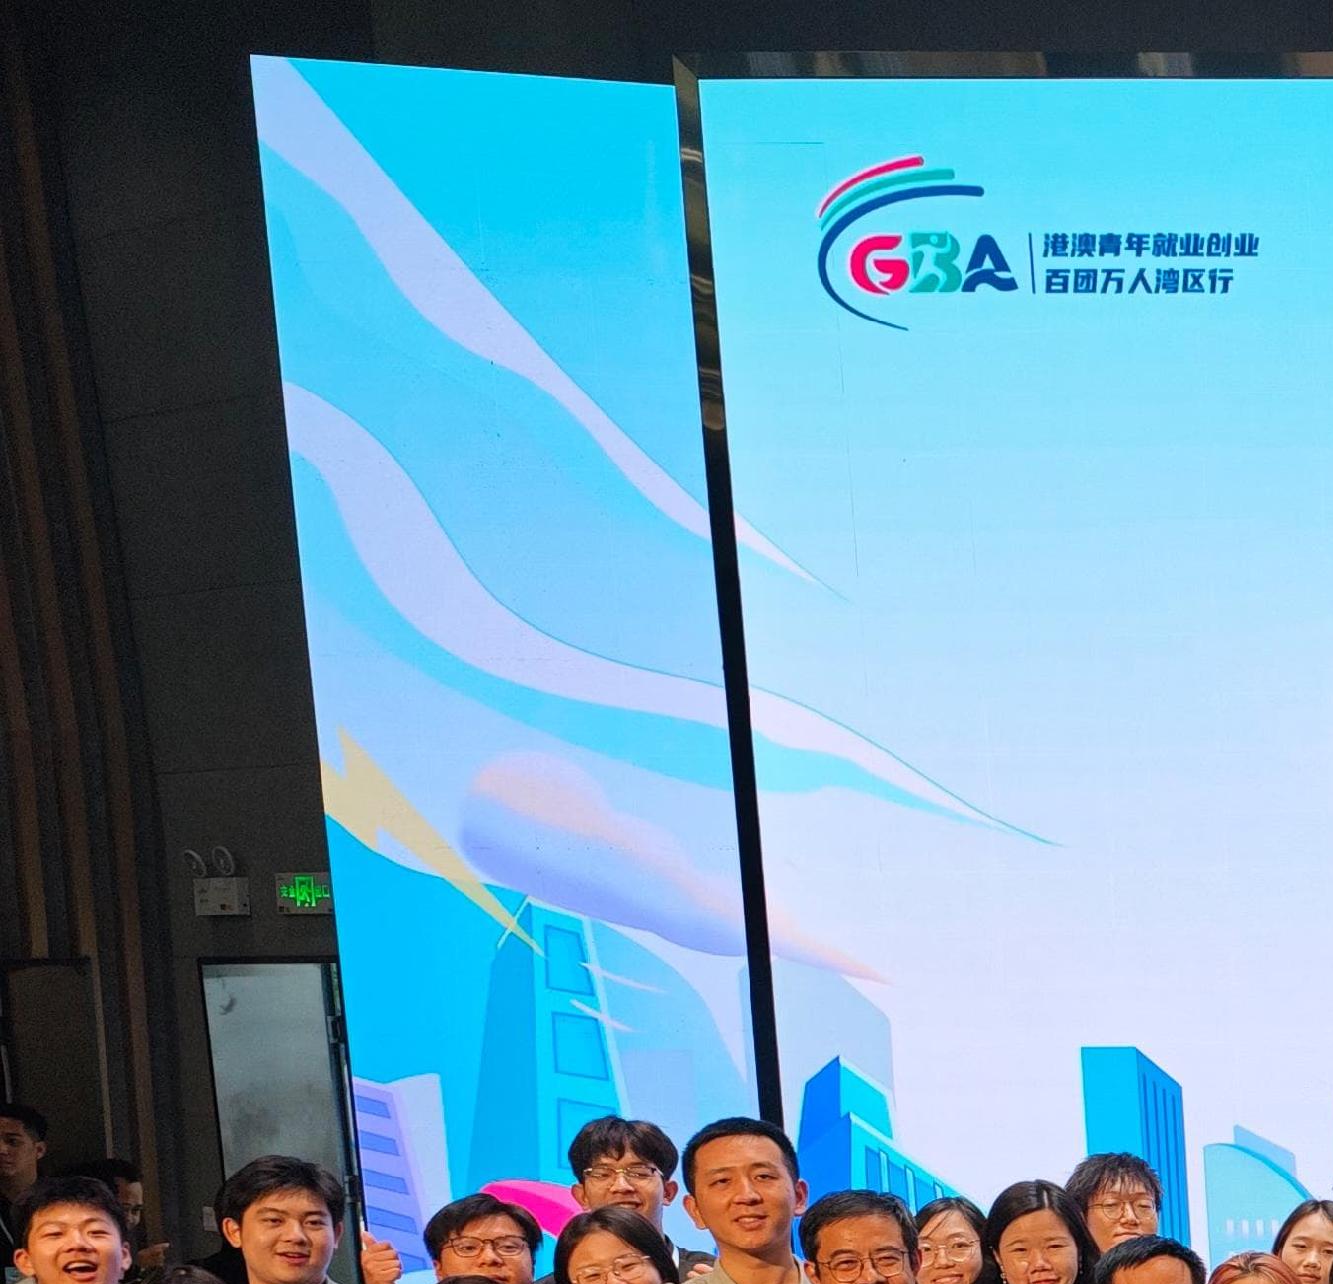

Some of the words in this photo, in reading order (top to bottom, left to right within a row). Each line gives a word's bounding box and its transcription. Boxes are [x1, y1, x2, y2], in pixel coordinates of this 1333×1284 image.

[1042, 233, 1260, 258] 港澳青年就业创业
[850, 231, 1018, 295] GBA
[1044, 268, 1234, 294] 百团万人湾区行
